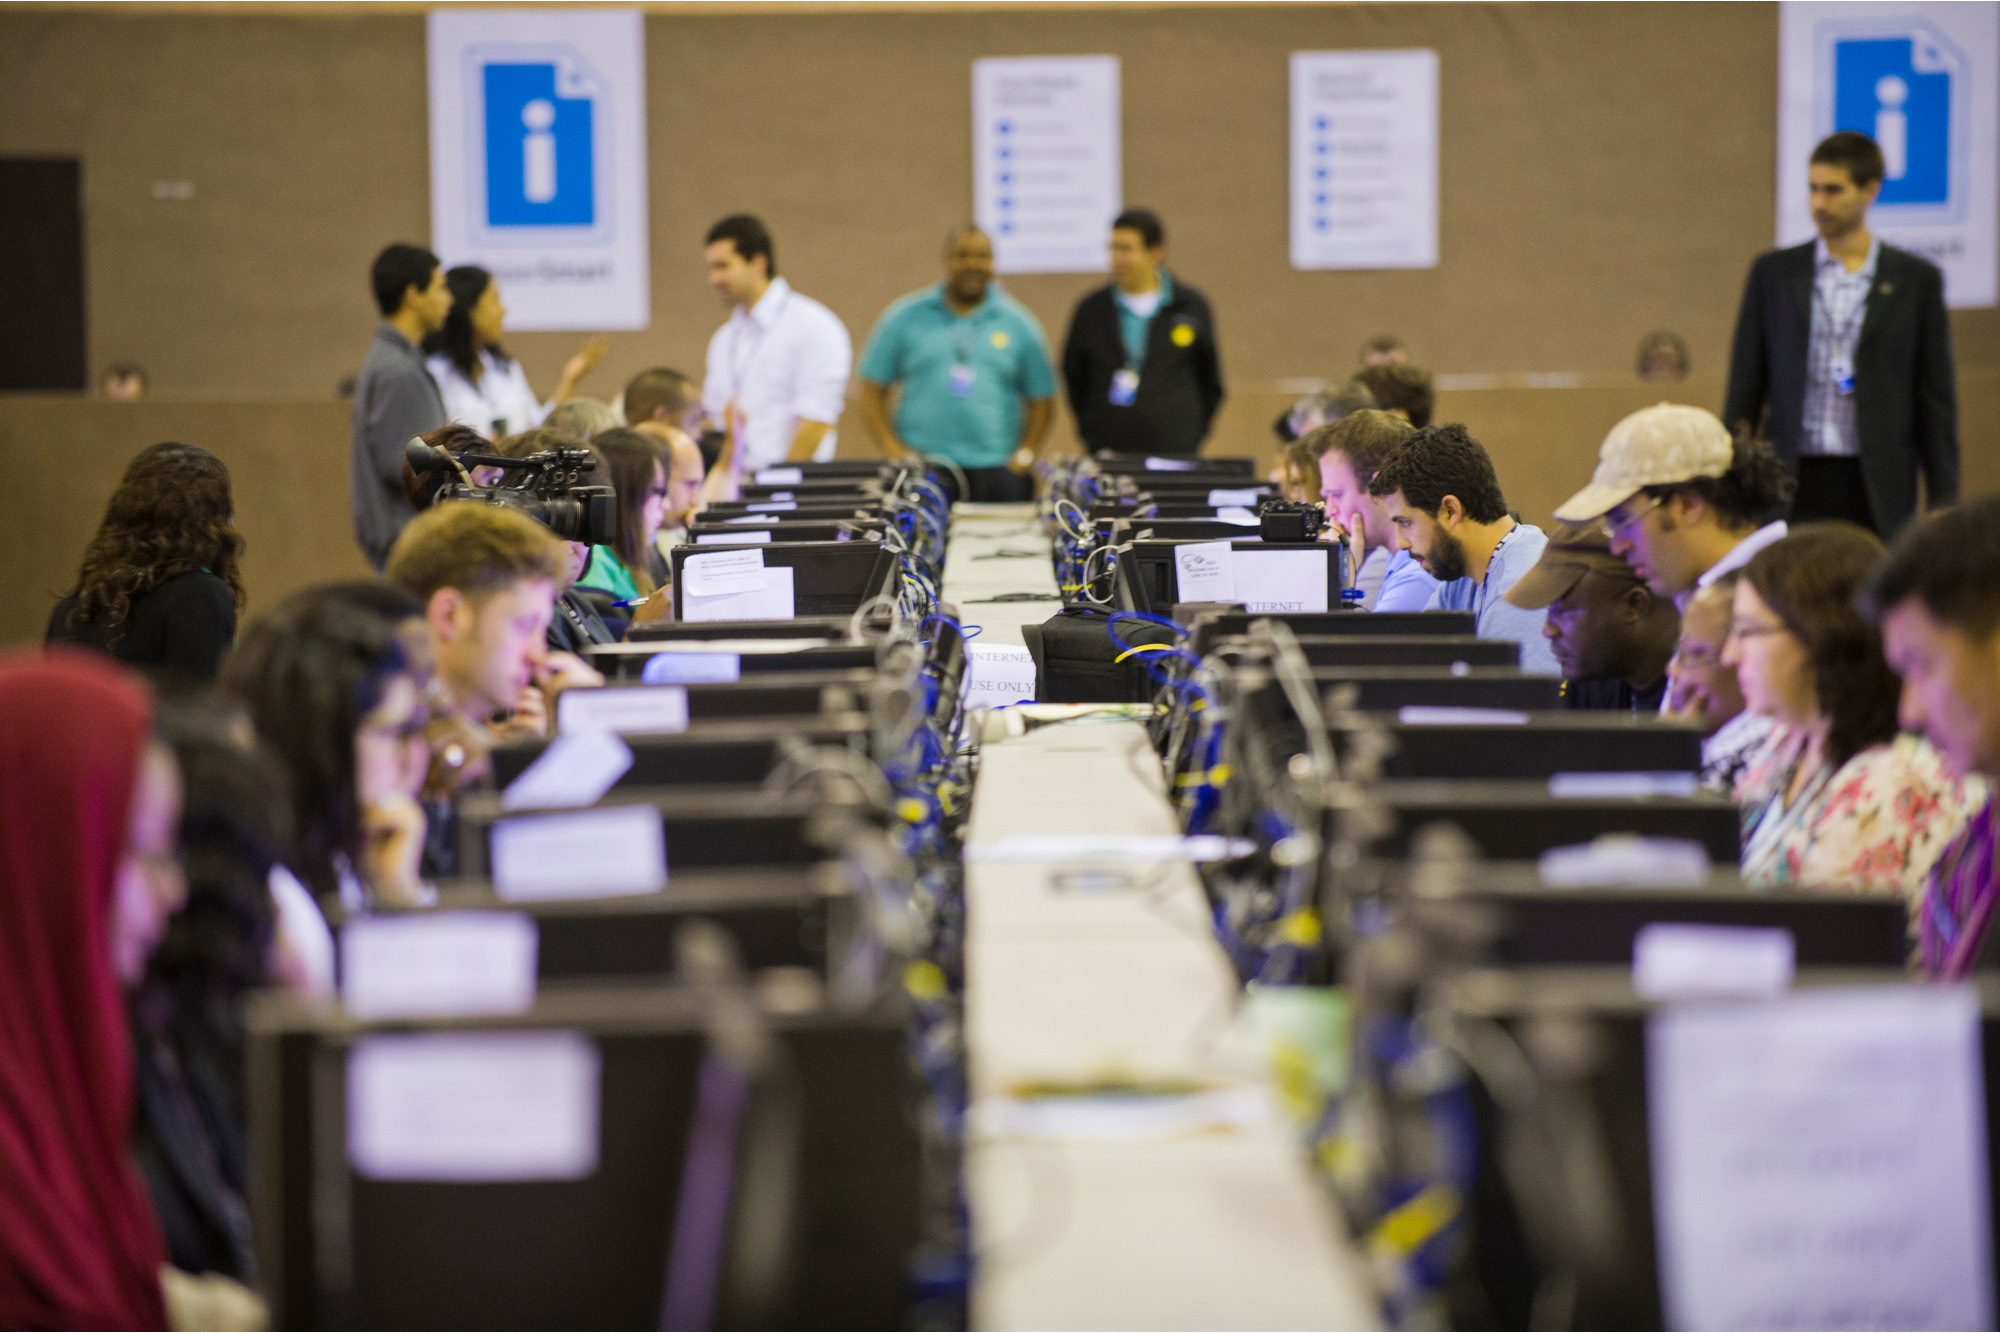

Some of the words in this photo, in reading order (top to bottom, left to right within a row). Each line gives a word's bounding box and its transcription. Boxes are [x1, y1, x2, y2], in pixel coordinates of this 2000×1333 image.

[1245, 602, 1304, 612] NTERNET
[969, 680, 994, 691] USE
[997, 681, 1035, 693] ONLY
